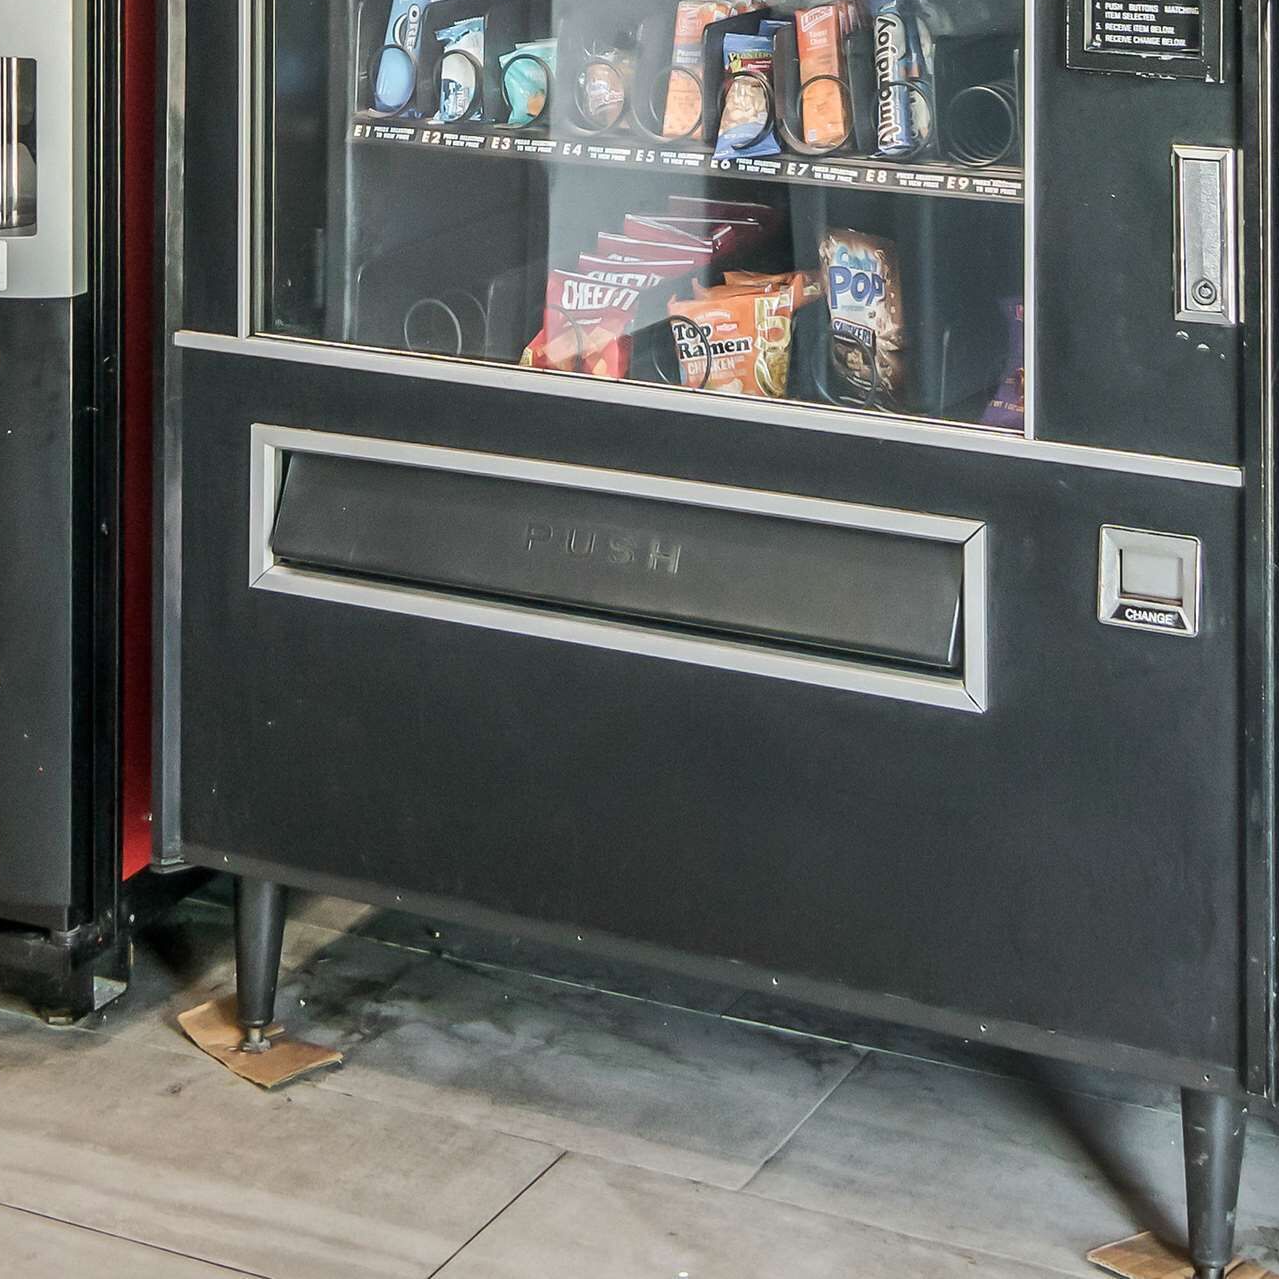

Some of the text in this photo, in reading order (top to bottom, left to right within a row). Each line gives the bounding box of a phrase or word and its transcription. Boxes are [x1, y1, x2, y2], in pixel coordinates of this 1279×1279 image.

[1105, 3, 1199, 15] PUSH BUTTONS MATCHING
[1105, 23, 1132, 32] RECEIVE
[1105, 35, 1161, 45] RECEIVE CHANGE
[877, 16, 901, 147] Almond Joy
[829, 266, 884, 309] POP
[674, 323, 712, 343] Top
[678, 336, 752, 360] Ramen
[687, 357, 736, 376] CHICKEN
[526, 524, 683, 576] PUSH
[1125, 608, 1174, 625] CHANGE
